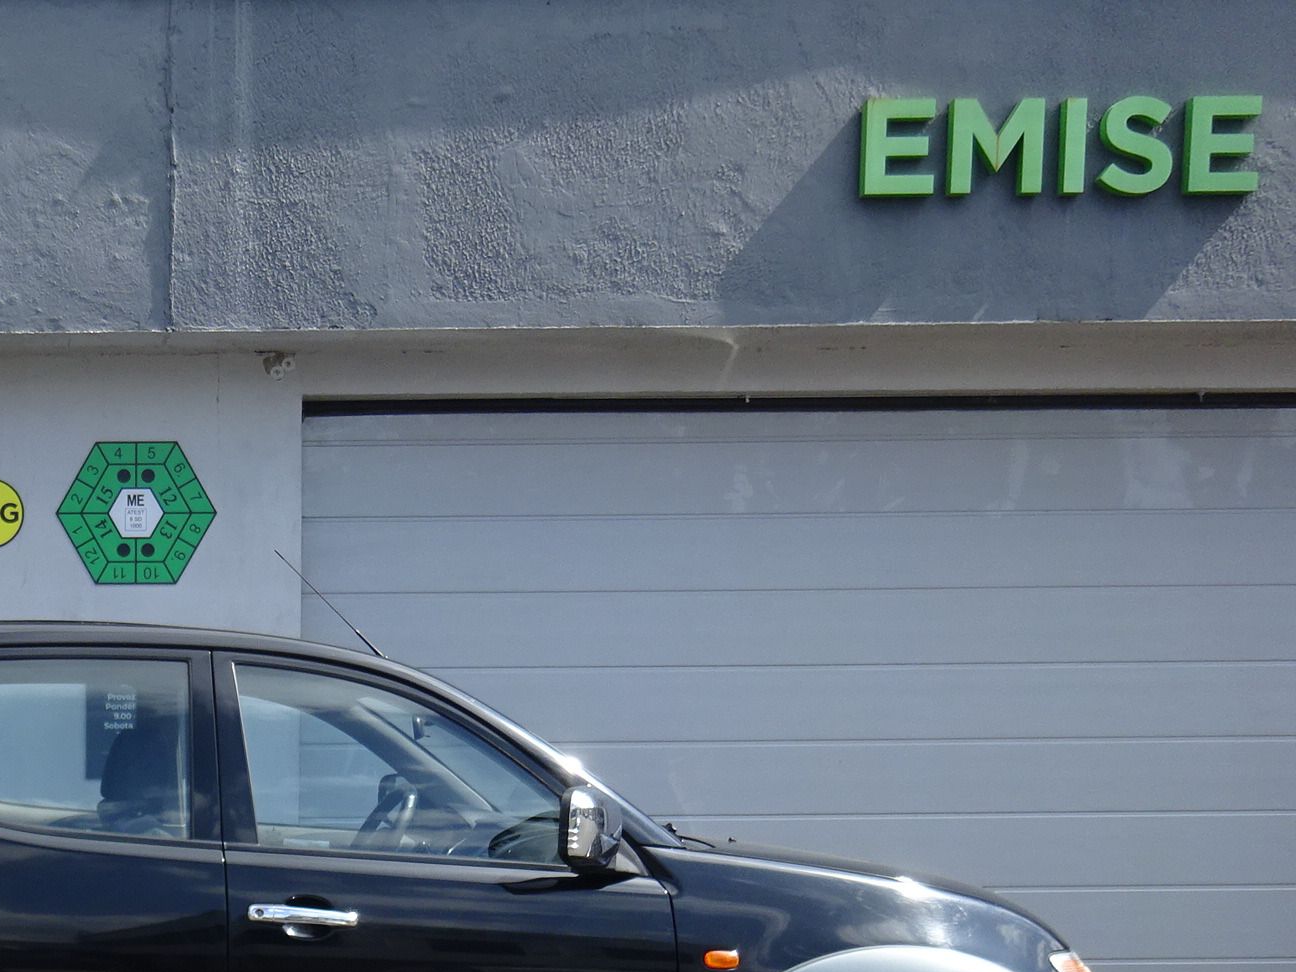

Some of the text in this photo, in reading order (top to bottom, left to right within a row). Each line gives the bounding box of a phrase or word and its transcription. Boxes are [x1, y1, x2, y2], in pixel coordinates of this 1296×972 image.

[859, 95, 1263, 197] EMISE
[114, 447, 123, 459] 4
[147, 447, 156, 459] 5
[86, 465, 99, 476] 3
[70, 493, 83, 505] 2
[96, 485, 114, 505] 15
[127, 494, 145, 507] ME
[159, 486, 177, 506] 12
[190, 491, 203, 501] 7
[95, 518, 113, 538] 14
[159, 521, 177, 540] 13
[189, 523, 201, 534] 8
[84, 547, 100, 565] 12
[113, 567, 127, 579] 11
[144, 567, 160, 580] 10
[104, 722, 134, 730] Sobota
